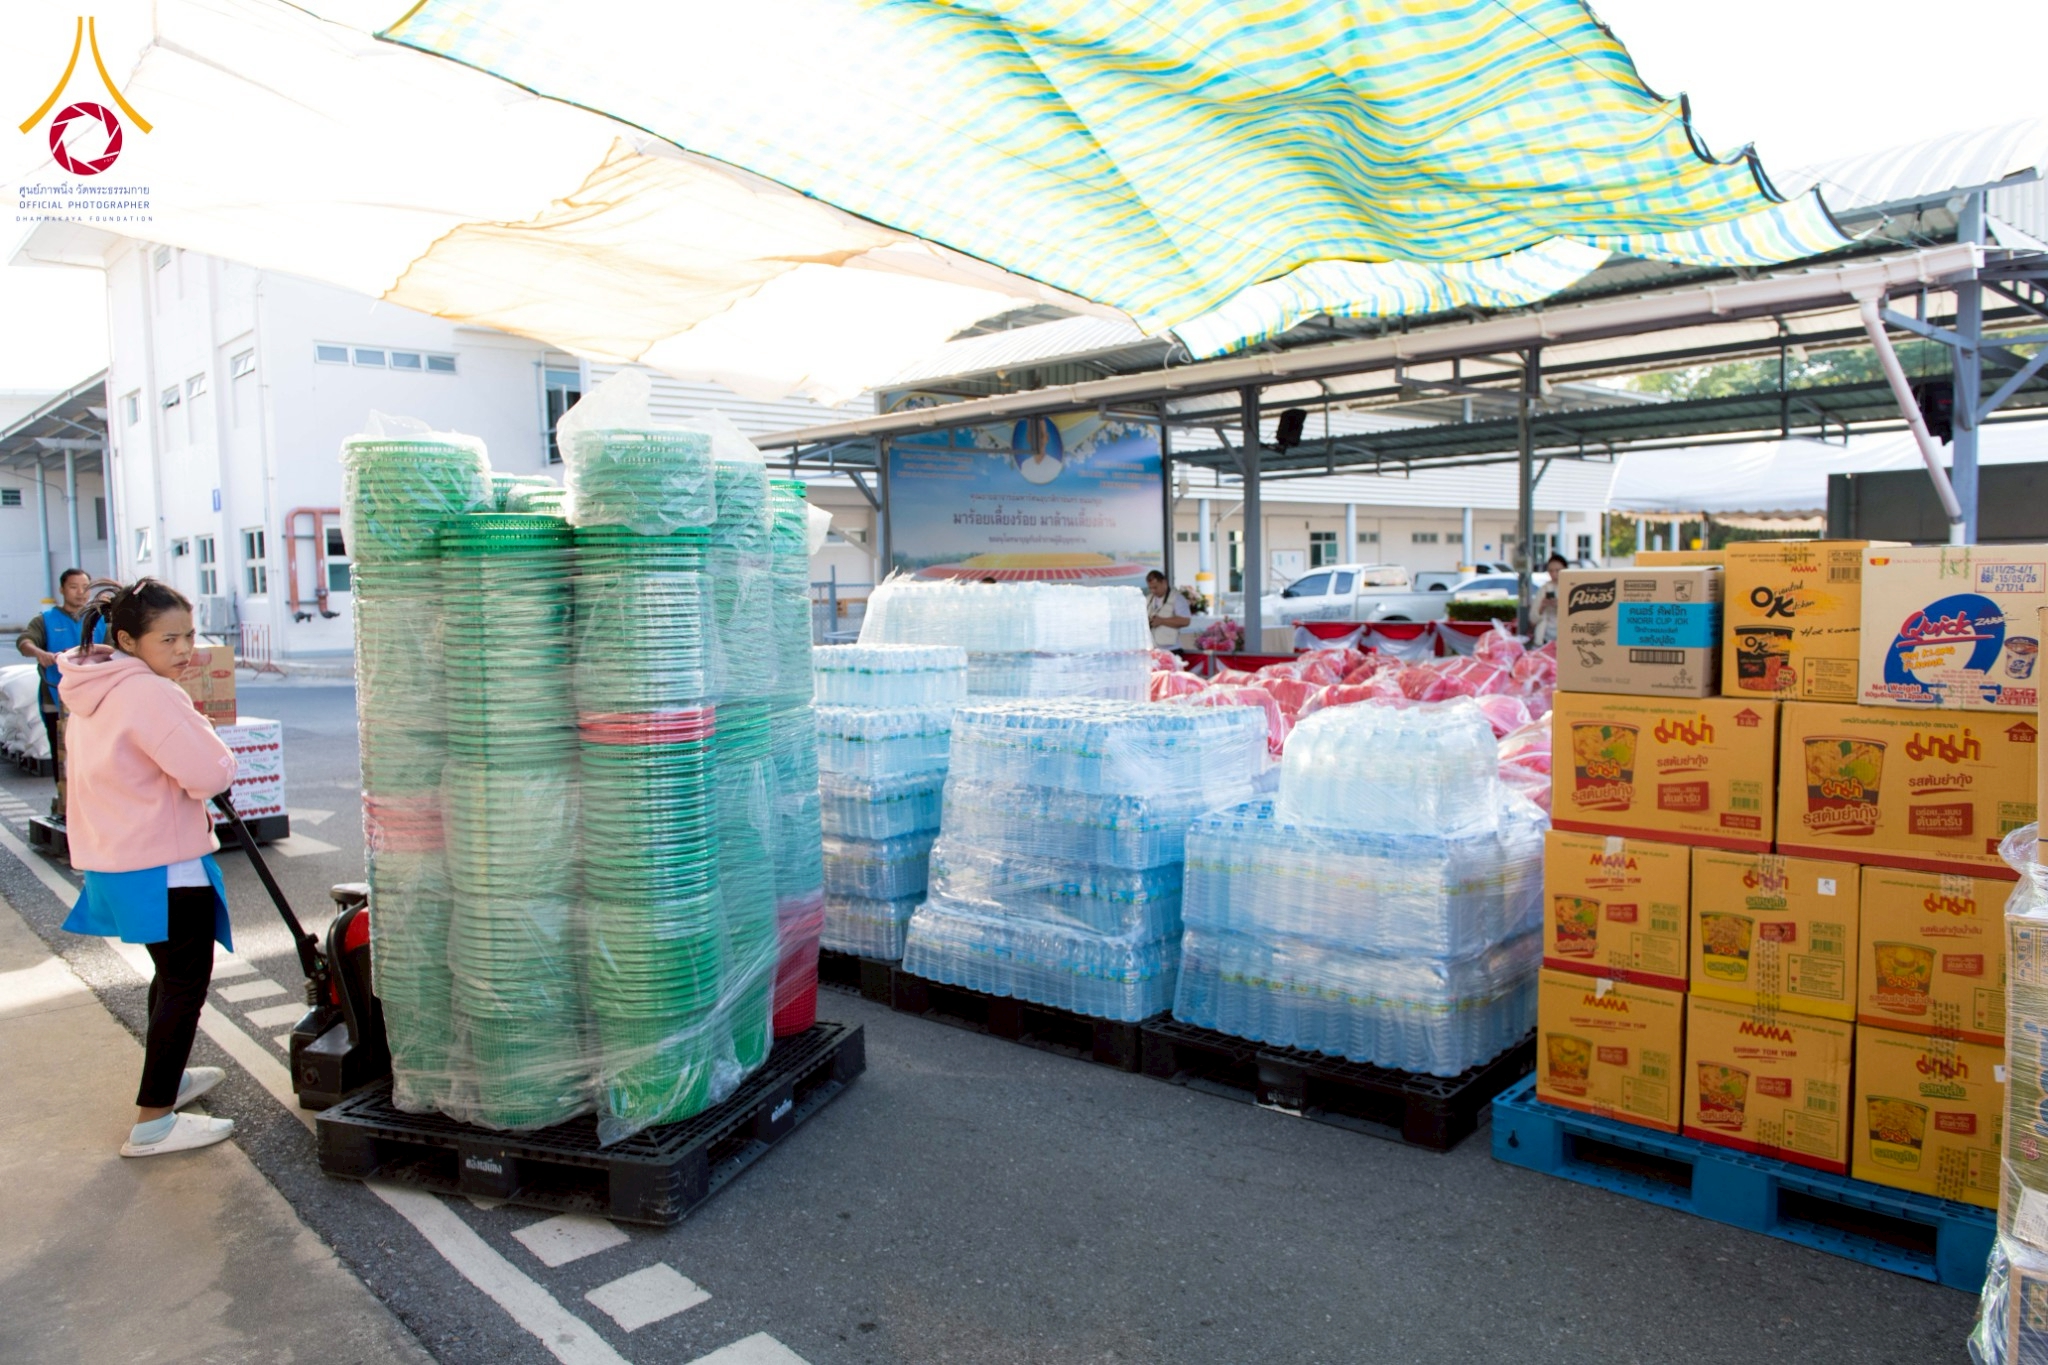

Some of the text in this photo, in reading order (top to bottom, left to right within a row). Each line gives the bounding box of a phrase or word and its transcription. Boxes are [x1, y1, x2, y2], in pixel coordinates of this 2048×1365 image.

[953, 505, 1117, 528] มาร้อยเลี้ยงร้อย มาล้านเลี้ยงล้าน
[1791, 565, 1817, 573] MAMA
[1569, 587, 1616, 609] คนอร์
[1629, 604, 1687, 616] คนอร์ คัพโจ๊ก
[1656, 617, 1672, 625] CUP
[1900, 610, 1972, 642] Quick
[1871, 683, 1921, 693] Net Weight
[1654, 715, 1715, 746] มาม่า
[1905, 728, 1982, 764] มาม่า
[1586, 759, 1621, 778] มาม่า
[1656, 754, 1709, 768] รสต้มยำกุ้ง
[1821, 777, 1863, 799] มาม่า
[1908, 773, 1973, 788] รสต้มยำกุ้ง
[1571, 783, 1634, 802] รสต้มยำกุ้ง
[1803, 804, 1879, 826] รสต้มยำกุ้ง
[1916, 815, 1963, 826] ต้นตำรับ
[1590, 854, 1637, 870] MAMA
[1923, 891, 1977, 916] มาม่า
[1583, 994, 1629, 1013] MAMA
[1739, 1021, 1793, 1043] MAMA
[1763, 1048, 1778, 1056] TOM
[1916, 1054, 1969, 1079] มาม่า
